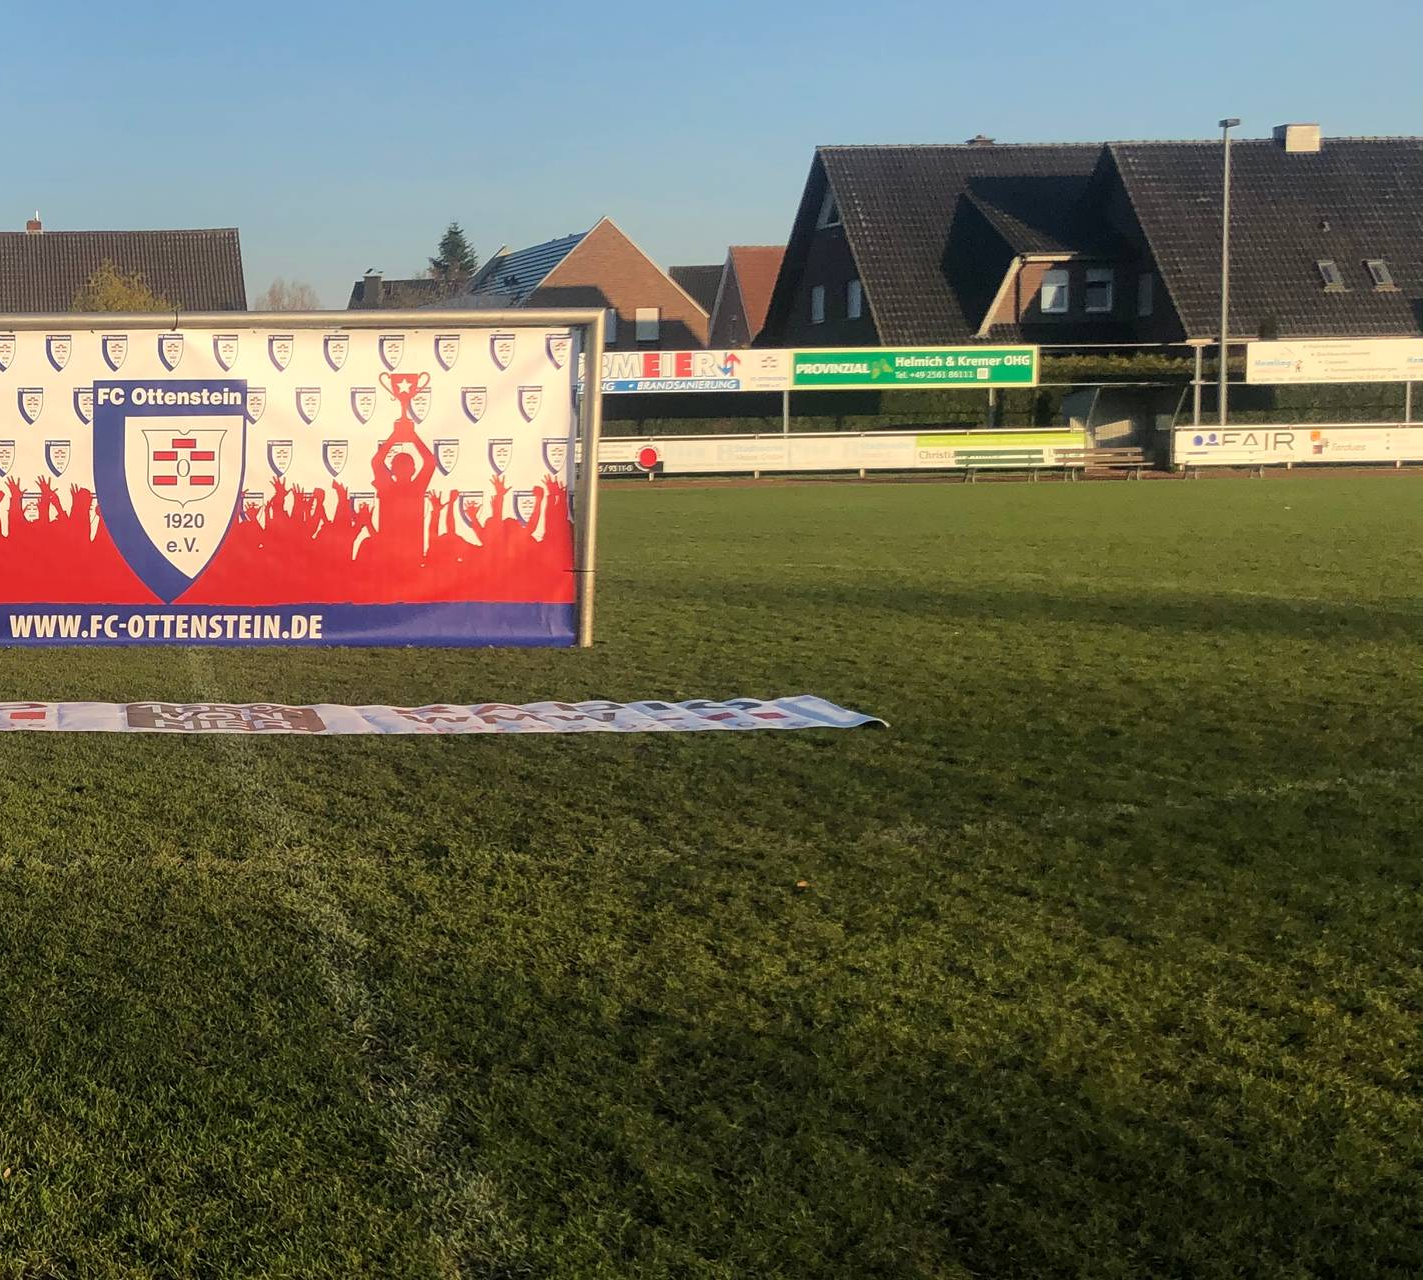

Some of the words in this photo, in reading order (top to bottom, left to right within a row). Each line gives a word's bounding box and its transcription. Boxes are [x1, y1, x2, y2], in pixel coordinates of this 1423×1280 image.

[895, 356, 943, 367] Helmich
[946, 356, 954, 366] &
[958, 355, 1001, 366] Kremer
[1004, 355, 1030, 366] OHG
[796, 363, 870, 375] PROVINZIAL
[636, 379, 737, 391] BRANDSANIERUNG
[97, 388, 125, 405] FC
[131, 387, 242, 405] Ottenstein
[164, 513, 205, 529] 1920
[9, 614, 323, 639] WWW.FC-OTTENSTEIN.DE
